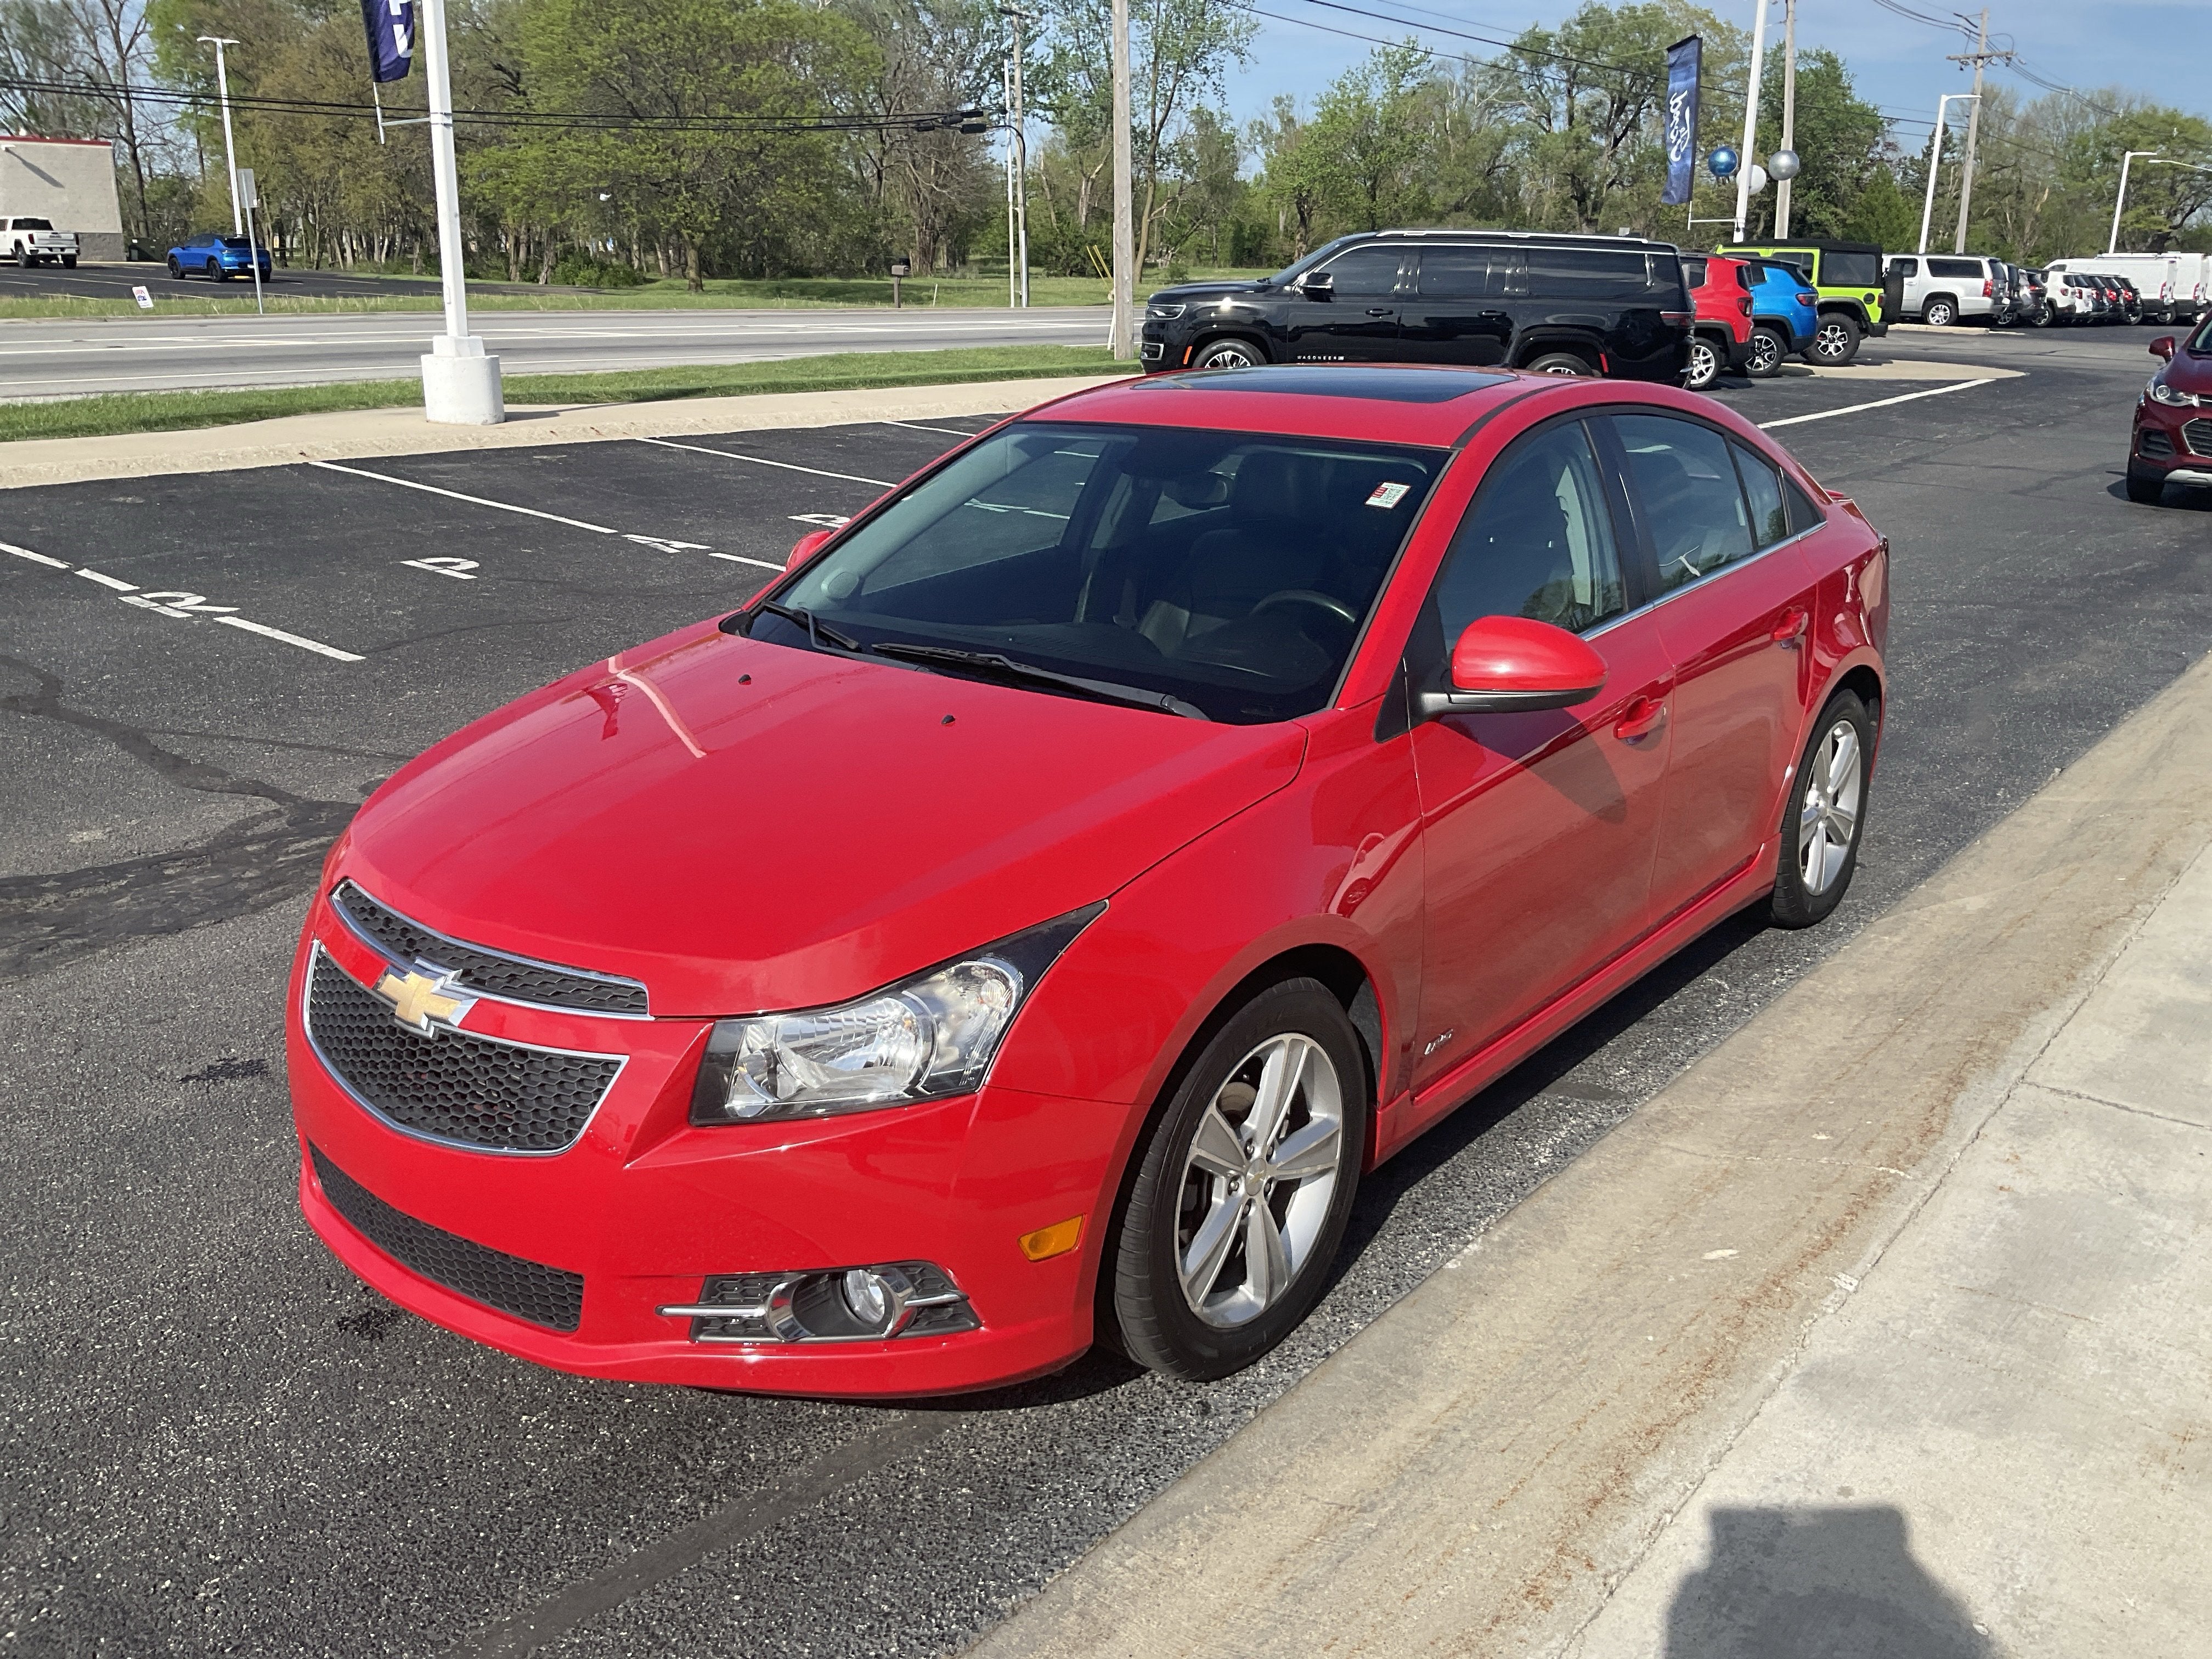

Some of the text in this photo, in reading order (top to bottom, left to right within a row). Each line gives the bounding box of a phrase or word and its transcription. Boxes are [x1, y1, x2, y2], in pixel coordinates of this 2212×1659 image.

[621, 534, 712, 554] A
[399, 557, 479, 579] P
[117, 591, 240, 618] R
